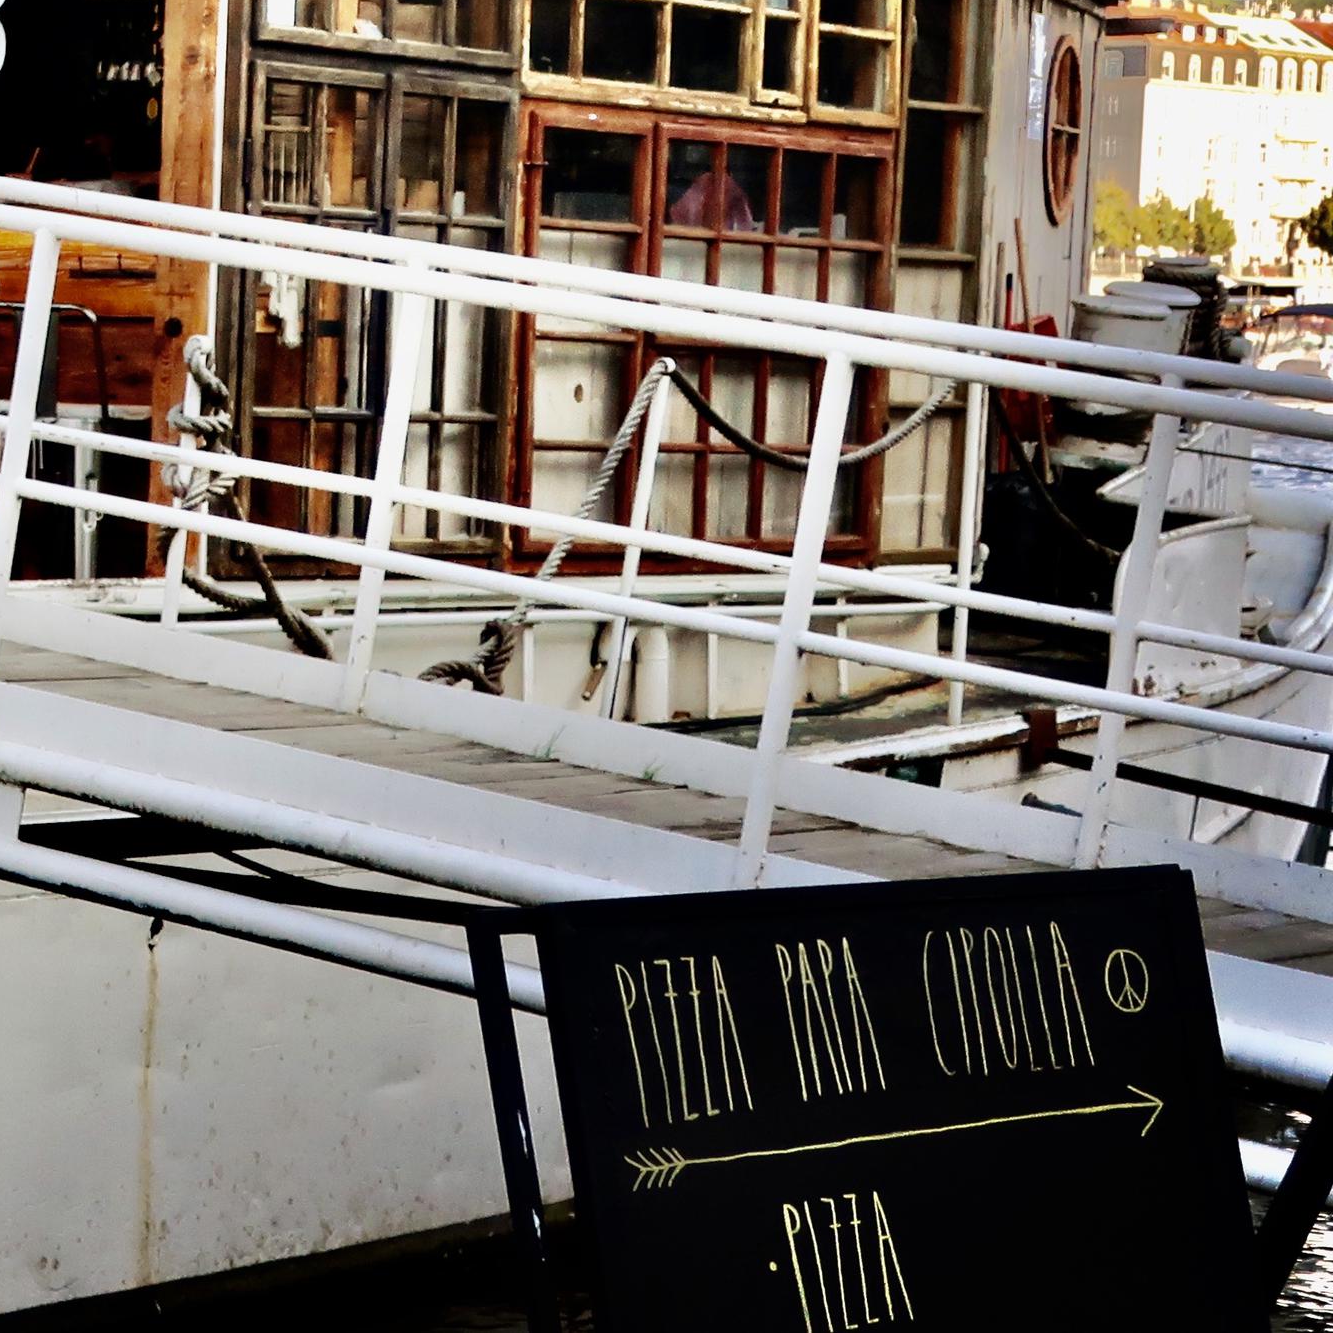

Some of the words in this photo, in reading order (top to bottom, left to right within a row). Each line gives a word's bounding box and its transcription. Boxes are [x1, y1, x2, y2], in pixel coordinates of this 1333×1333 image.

[614, 956, 754, 1128] PIZZA
[774, 936, 886, 1103] PAPA
[922, 920, 1095, 1077] CIPOLLA
[782, 1190, 914, 1333] PIZZA
